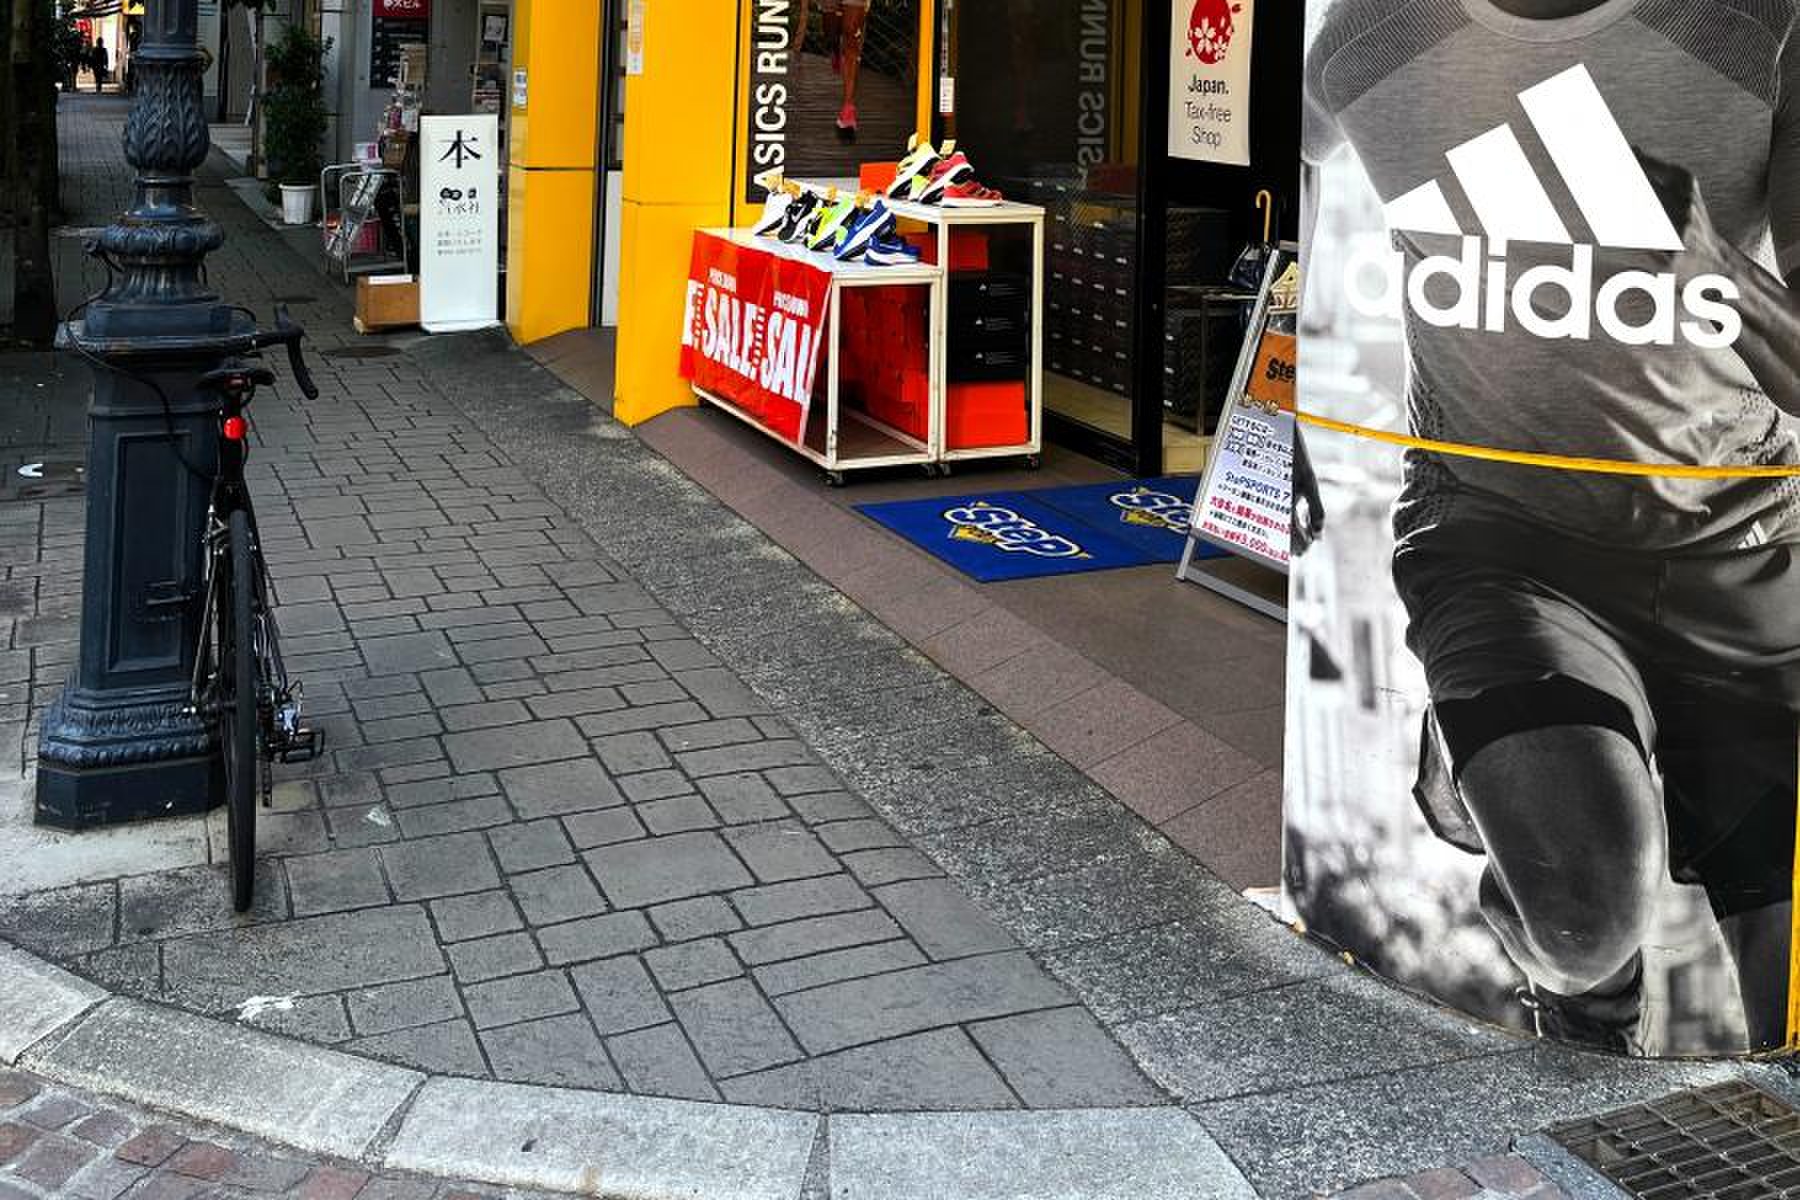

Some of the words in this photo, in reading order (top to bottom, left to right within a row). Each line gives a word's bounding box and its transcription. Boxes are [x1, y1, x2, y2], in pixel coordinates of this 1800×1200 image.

[1187, 74, 1229, 96] Japan.
[1185, 101, 1232, 122] Tax-free
[437, 130, 482, 168] 本
[753, 82, 788, 189] ASICS
[1192, 125, 1222, 150] Shop
[1344, 232, 1743, 349] adidas
[702, 287, 757, 382] SALE
[1265, 351, 1298, 384] Ste
